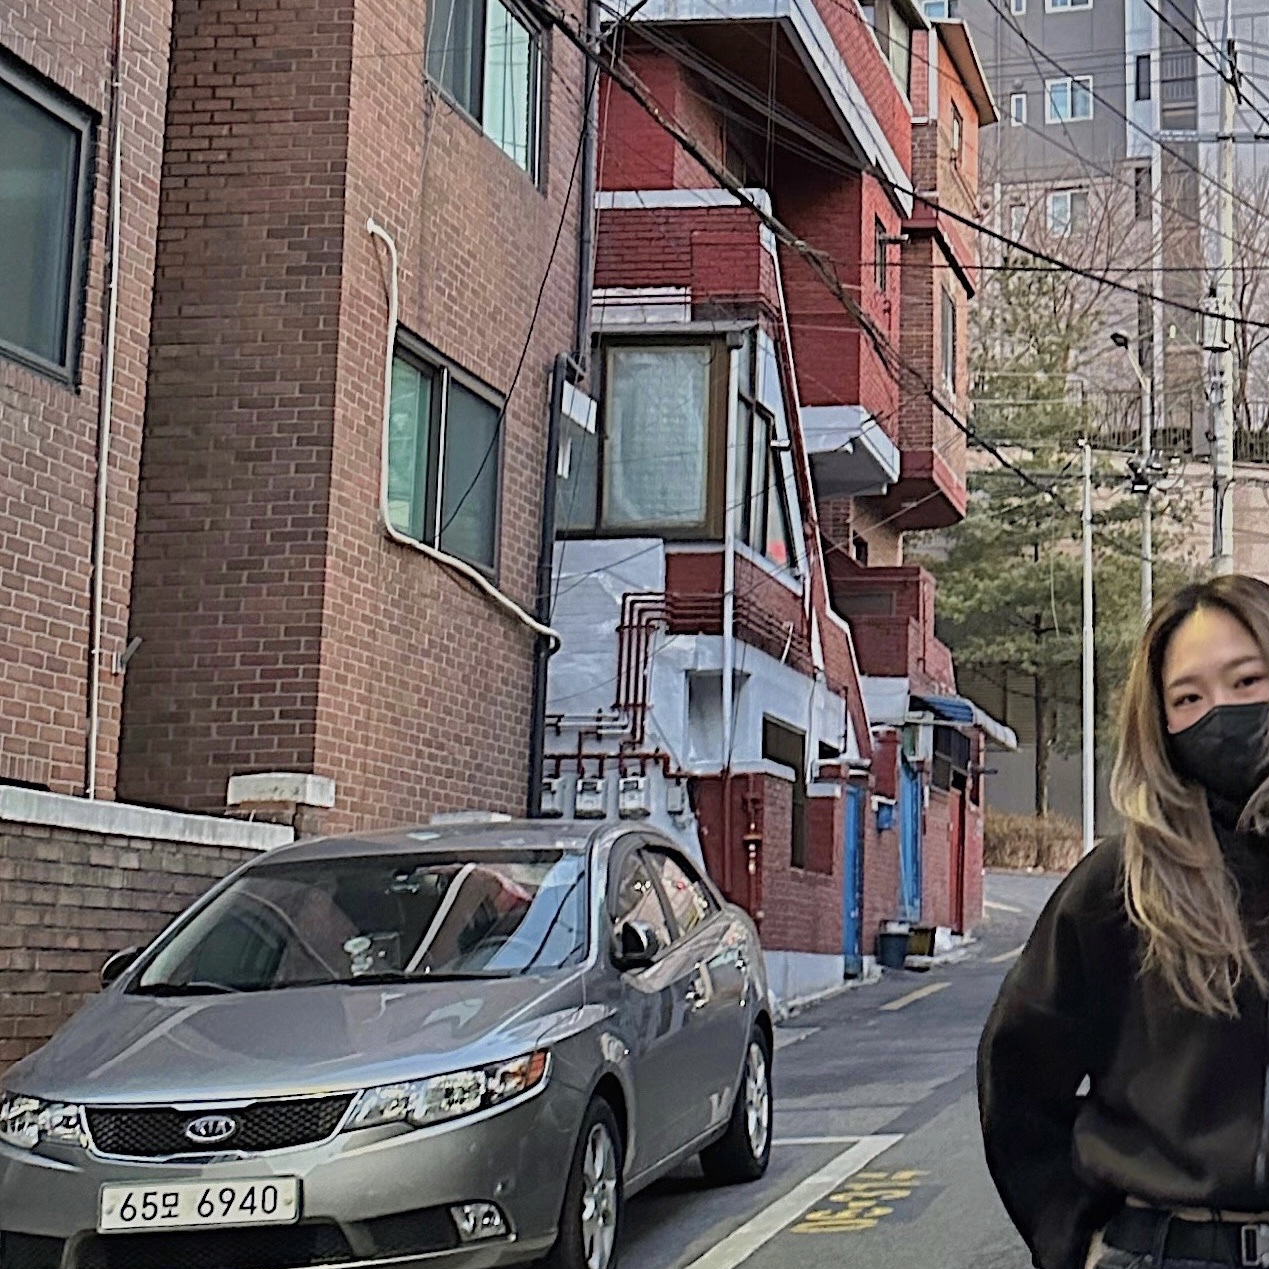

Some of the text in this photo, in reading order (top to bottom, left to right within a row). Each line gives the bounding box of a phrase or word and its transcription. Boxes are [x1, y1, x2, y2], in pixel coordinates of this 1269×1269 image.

[192, 1118, 231, 1137] KIA
[120, 1185, 278, 1222] 65모 6940
